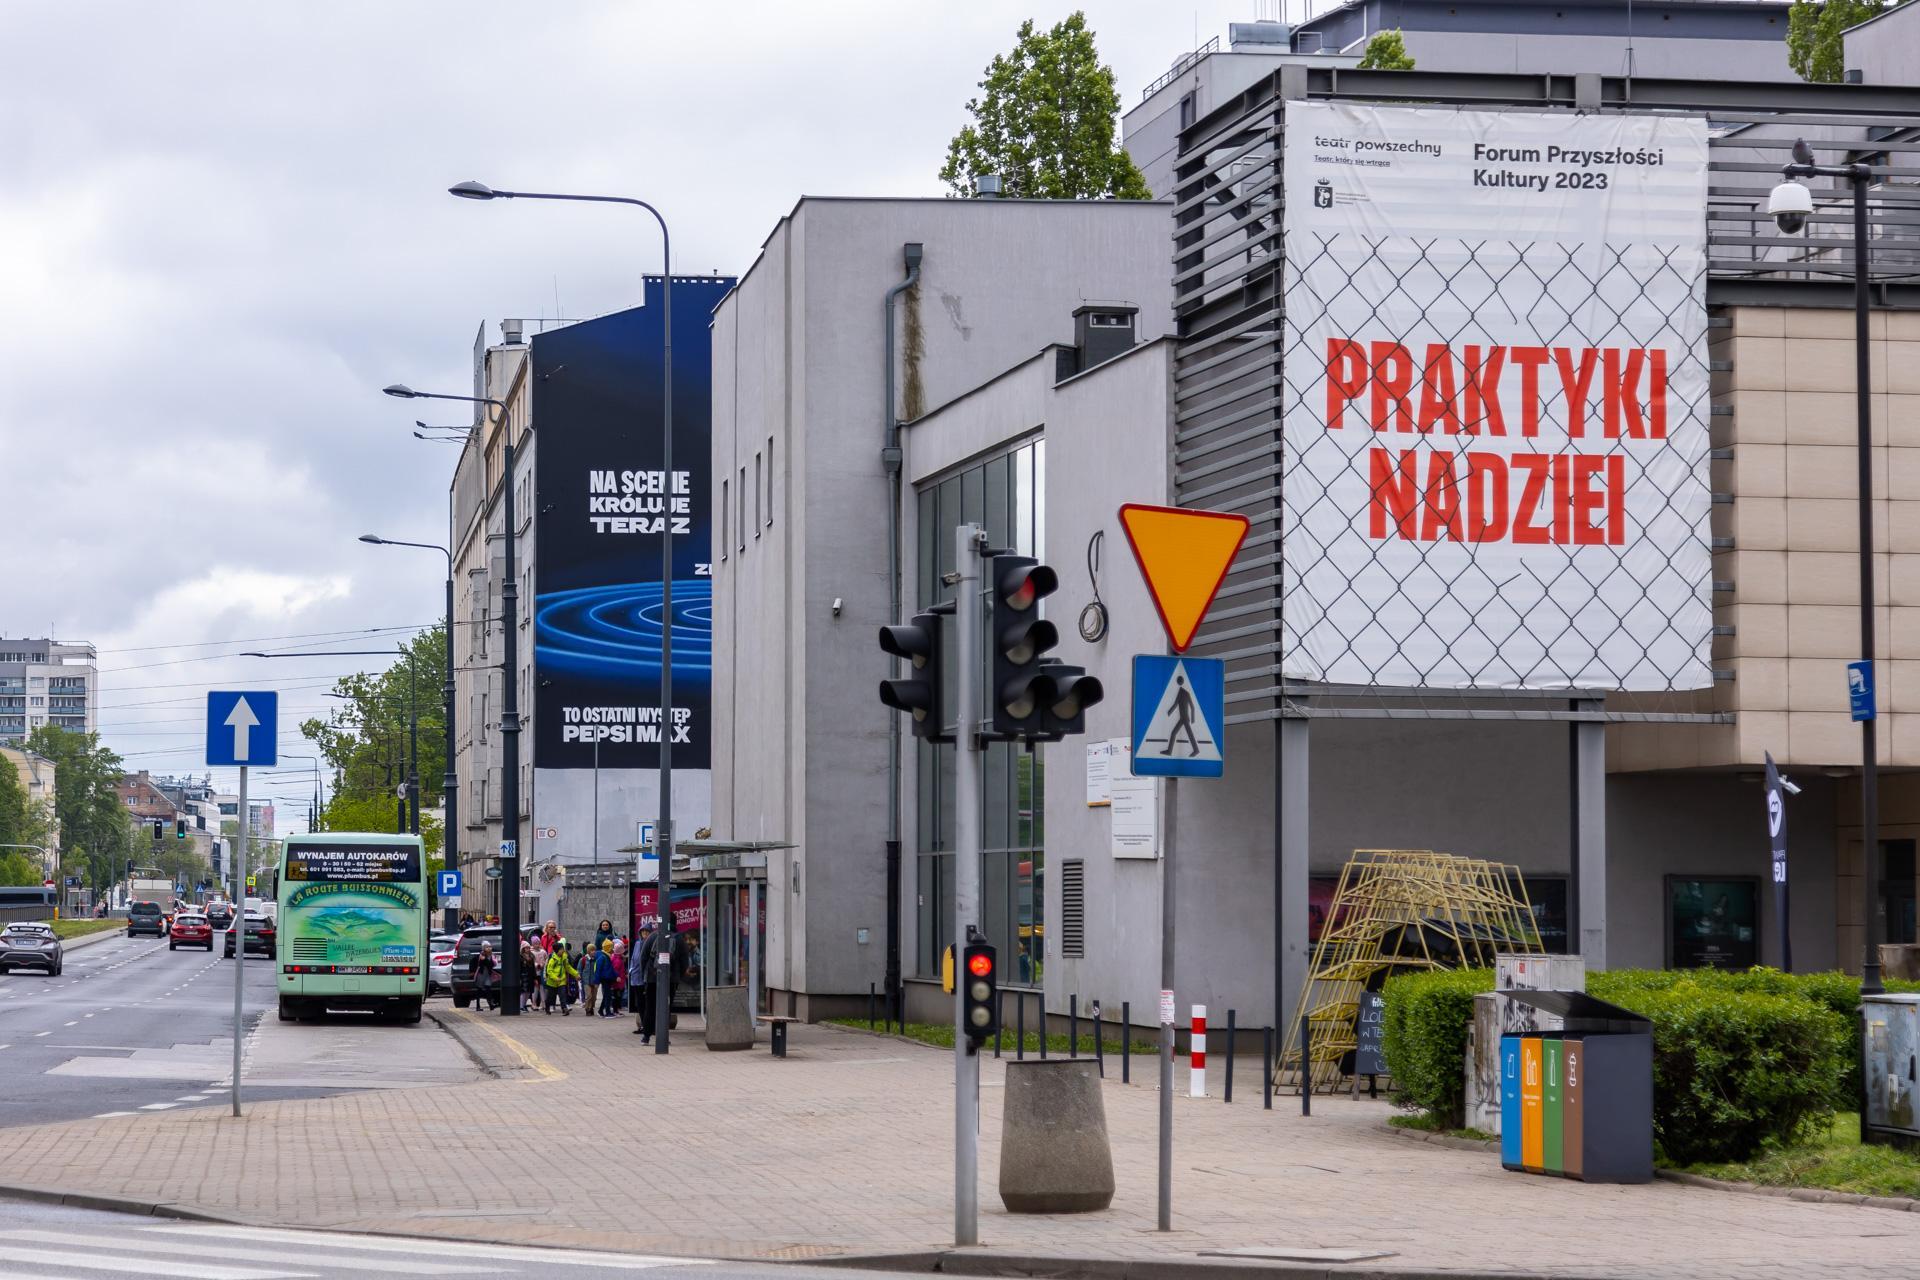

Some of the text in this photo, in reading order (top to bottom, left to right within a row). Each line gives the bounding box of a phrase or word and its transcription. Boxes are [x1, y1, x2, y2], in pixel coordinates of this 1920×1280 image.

[1315, 136, 1442, 157] teatr powszechny
[1474, 143, 1664, 168] Forum Przyszłości
[1473, 168, 1608, 192] Kultury 2023
[1327, 337, 1667, 440] PRAKTYKI
[590, 470, 618, 493] NA
[590, 494, 690, 513] KRÓLUJE
[1370, 447, 1625, 546] NADZIEI
[590, 517, 690, 533] TERAZ
[695, 563, 713, 575] Z
[563, 707, 580, 723] TO
[583, 707, 636, 723] OSTATNI
[563, 725, 632, 743] PEPSI
[297, 851, 408, 860] WYNAJEM AUTOKARÓW
[443, 874, 457, 893] P
